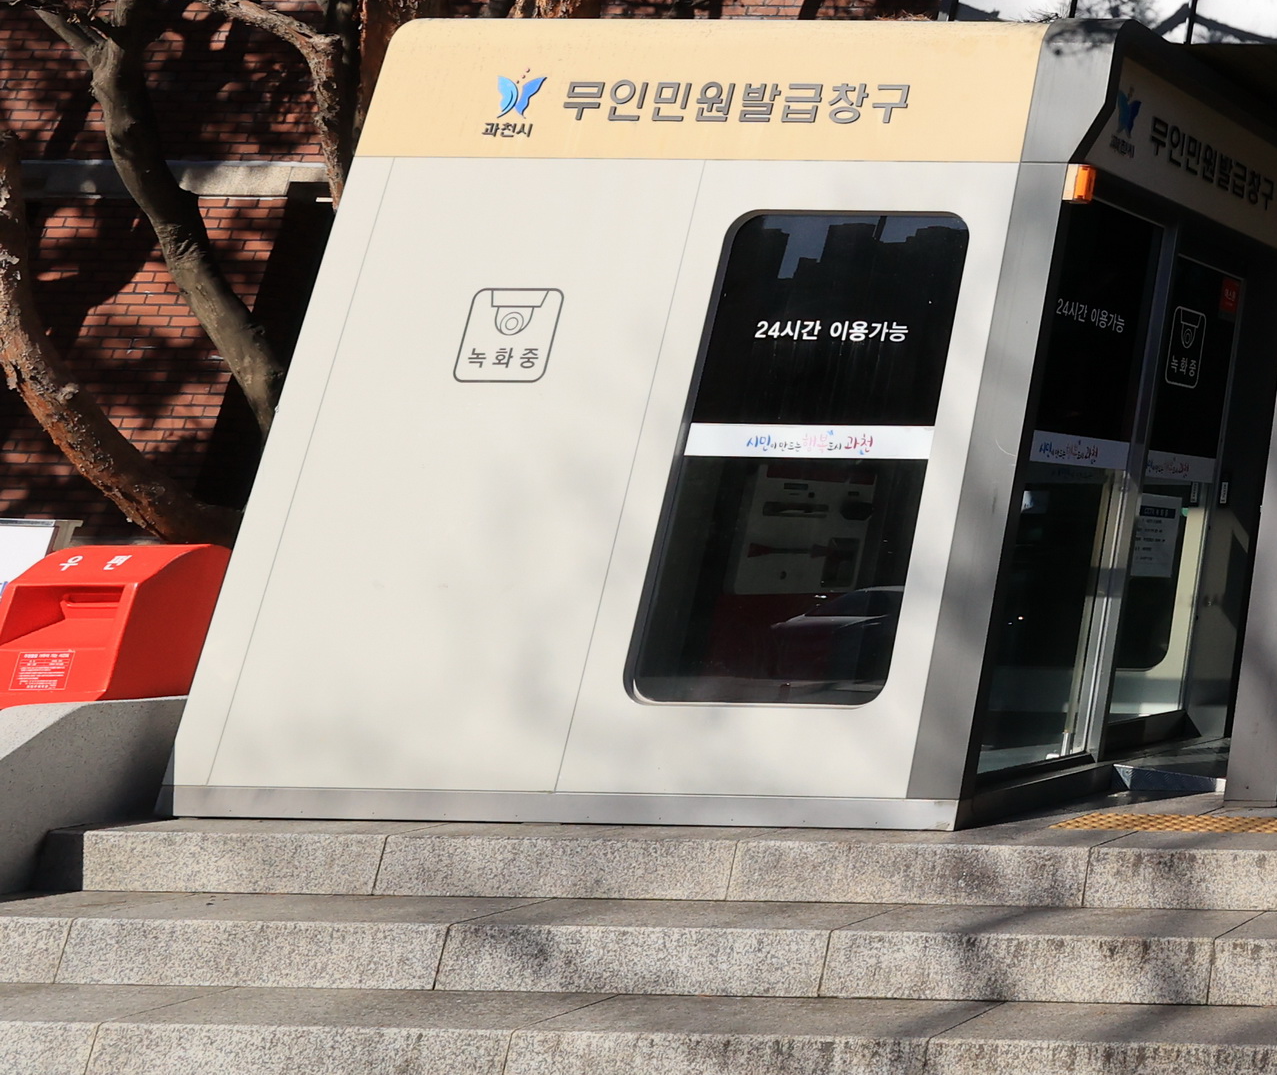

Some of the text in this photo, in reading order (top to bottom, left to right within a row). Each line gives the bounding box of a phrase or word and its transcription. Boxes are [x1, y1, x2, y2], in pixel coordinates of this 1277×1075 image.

[563, 79, 911, 124] 무인민원발급창구
[481, 122, 534, 138] 과천시
[1150, 116, 1275, 211] 무인민원발급창구
[1056, 298, 1125, 333] 24시간 이용가능
[754, 320, 909, 342] 24시간 이용가능
[746, 434, 776, 452] 시민이
[778, 441, 802, 452] 만드는
[844, 432, 874, 453] 과천
